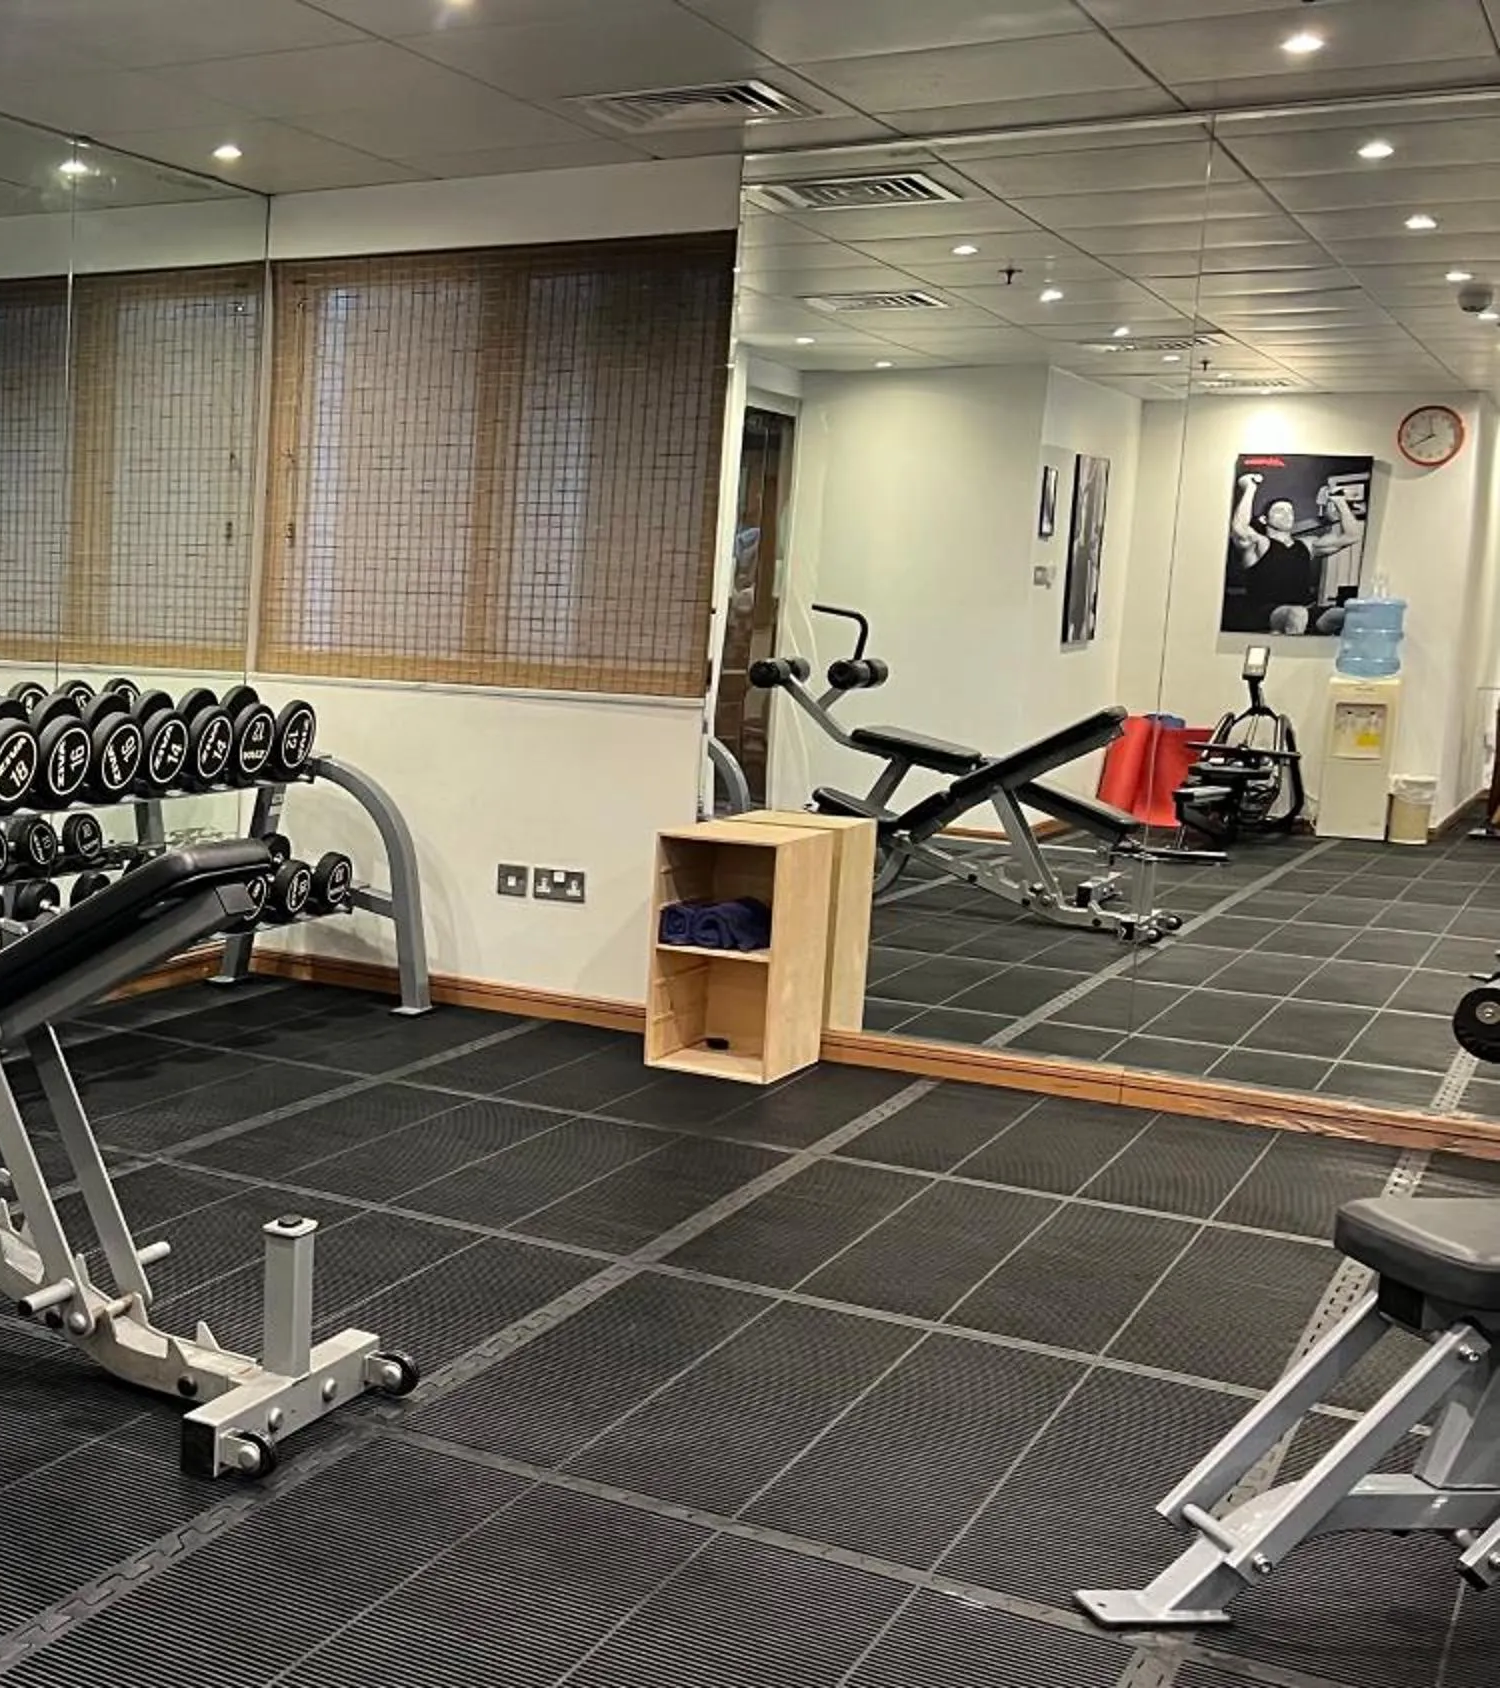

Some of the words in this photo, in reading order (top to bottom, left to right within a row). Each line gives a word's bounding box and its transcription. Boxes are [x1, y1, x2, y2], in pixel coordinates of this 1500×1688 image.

[251, 721, 265, 742] 12
[285, 729, 299, 750] 12
[70, 745, 85, 772] 16
[121, 735, 137, 763] 16
[167, 743, 183, 763] 14
[211, 739, 227, 760] 14
[9, 760, 29, 787] 18
[57, 740, 66, 788] ZIVA
